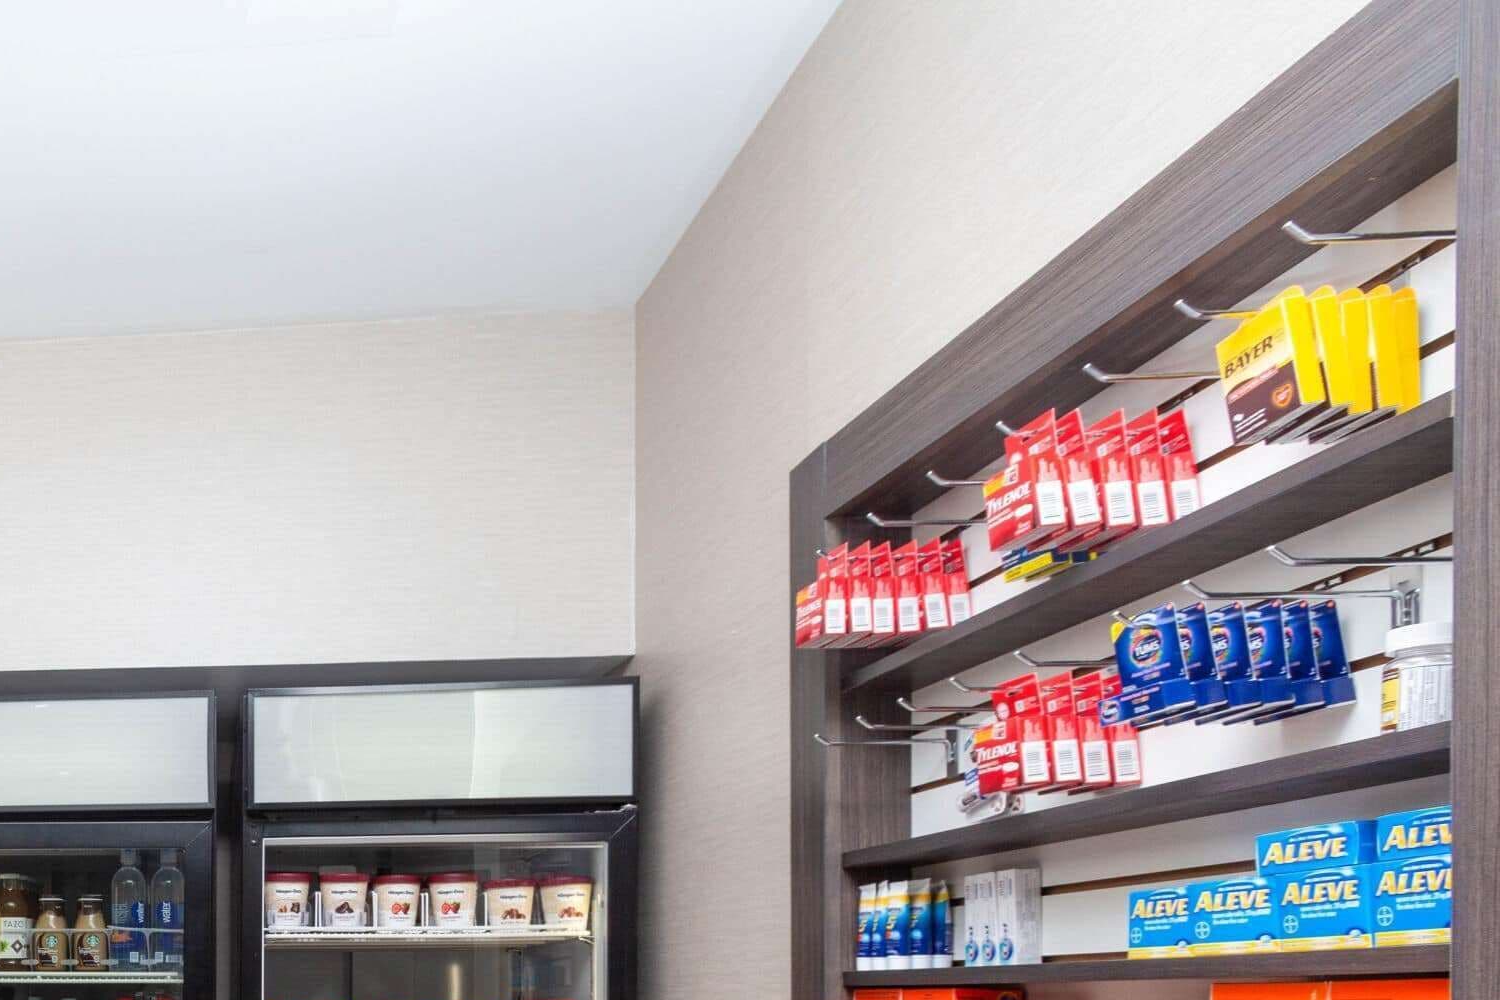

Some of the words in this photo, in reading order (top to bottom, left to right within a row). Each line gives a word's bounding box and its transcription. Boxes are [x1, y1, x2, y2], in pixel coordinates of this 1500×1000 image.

[1224, 335, 1273, 378] BAYER
[1262, 837, 1347, 866] ALEVE
[1195, 889, 1271, 913] ALEVE
[1282, 880, 1360, 905] ALEVE
[163, 901, 172, 924] water
[1131, 899, 1188, 919] ALEVE
